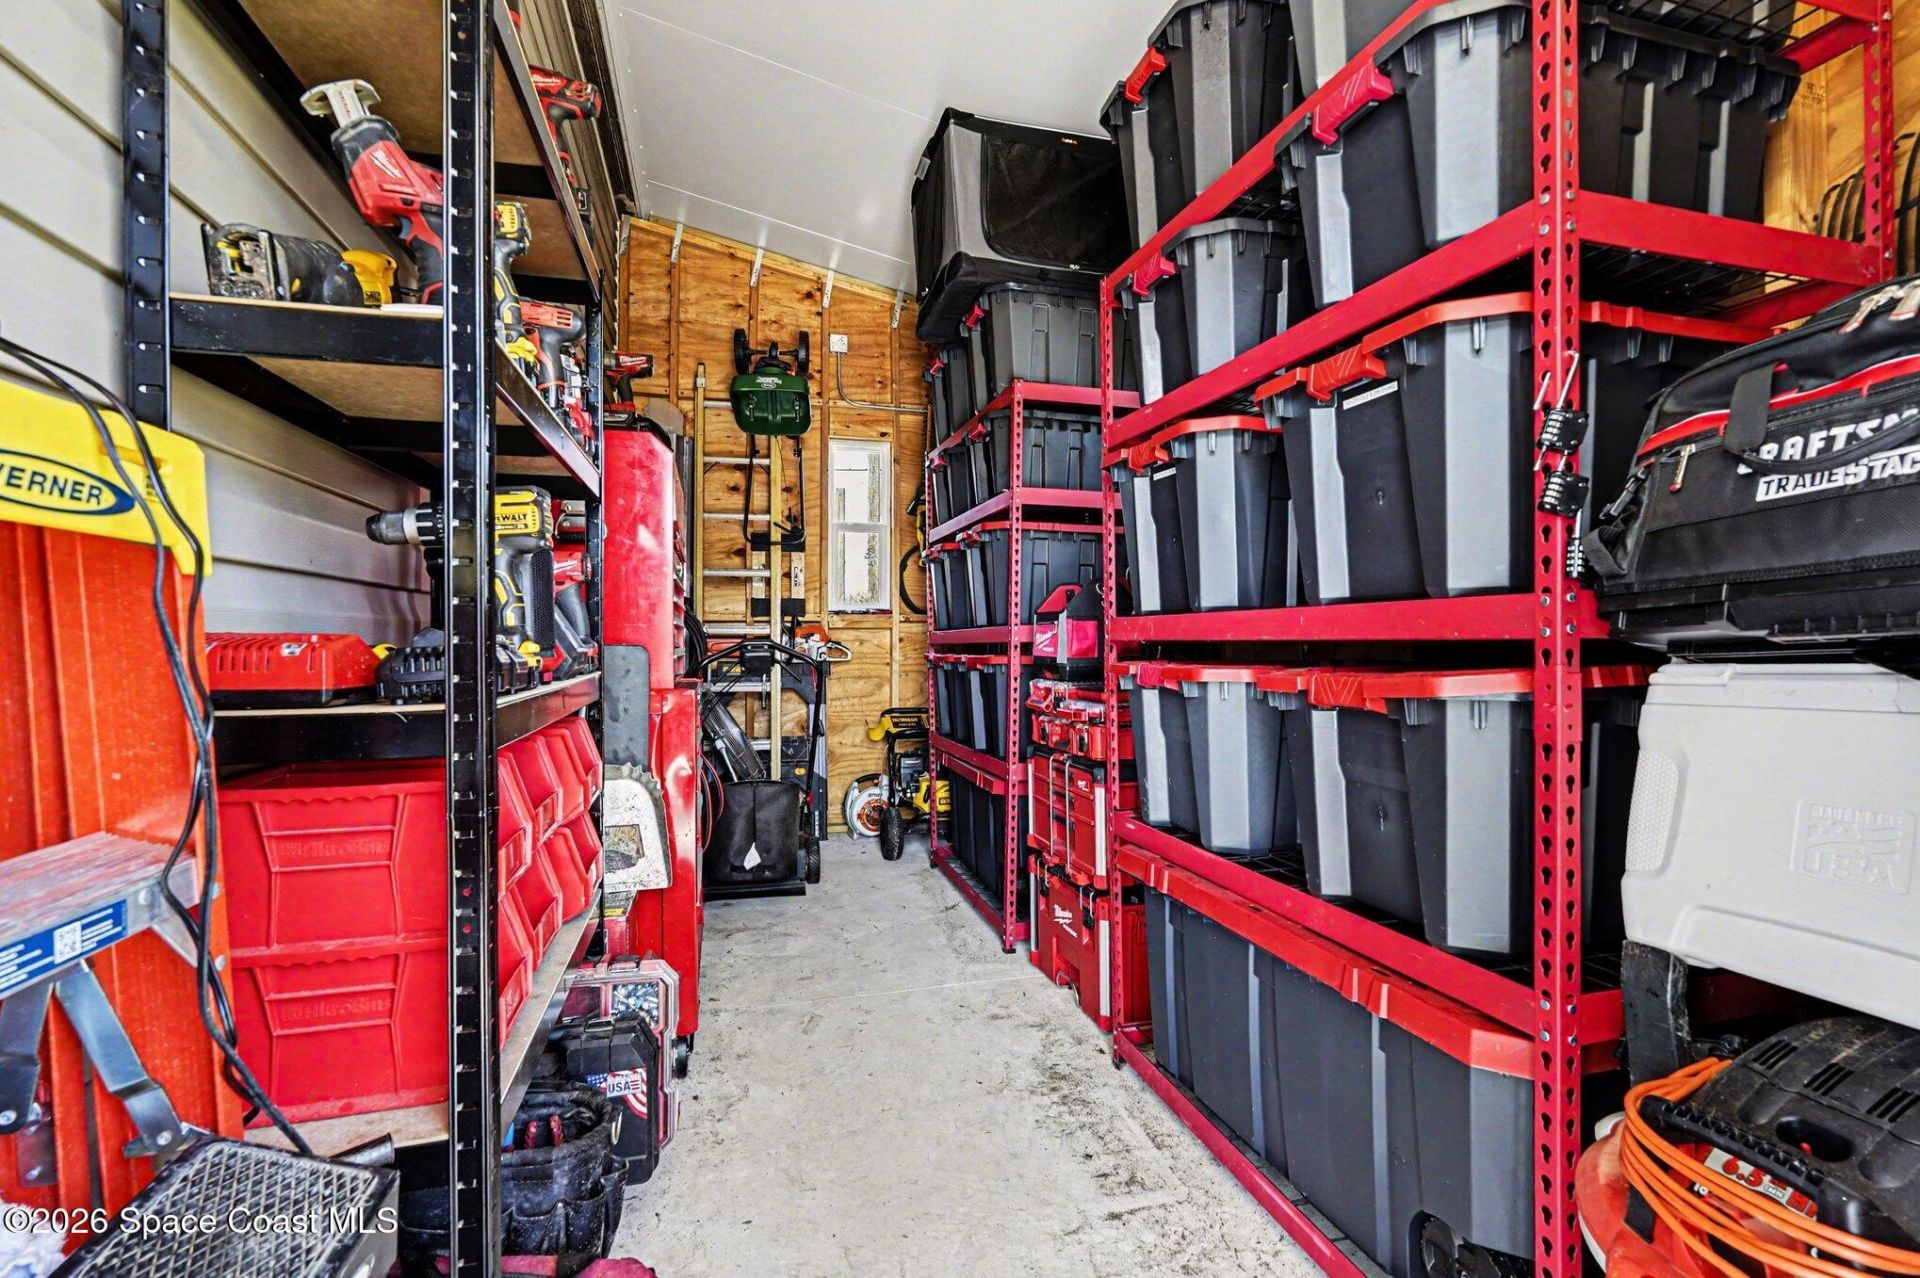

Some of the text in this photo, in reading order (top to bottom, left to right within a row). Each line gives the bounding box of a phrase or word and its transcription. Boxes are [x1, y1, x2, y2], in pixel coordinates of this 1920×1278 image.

[0, 463, 102, 506] ERNER
[608, 1081, 631, 1093] USA
[1722, 1156, 1767, 1188] 6.5
